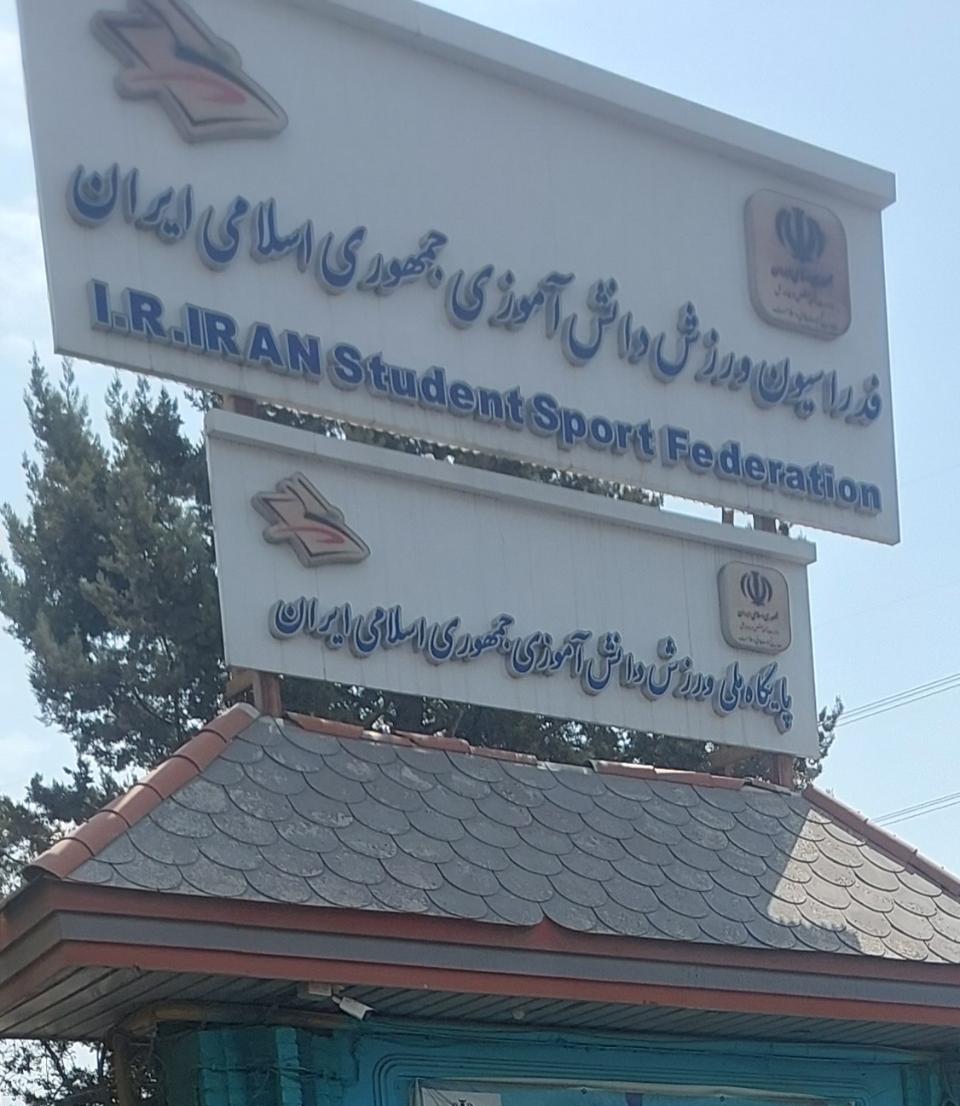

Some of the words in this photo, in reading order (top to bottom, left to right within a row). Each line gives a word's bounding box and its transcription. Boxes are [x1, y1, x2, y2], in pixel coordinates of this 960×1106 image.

[68, 164, 194, 243] ایران
[200, 195, 315, 271] اسلامی
[317, 226, 447, 295] جمهوری
[447, 264, 574, 338] آموزی
[562, 277, 649, 367] دانش
[649, 302, 752, 389] ورزش
[88, 279, 324, 384] I.R.IRAN
[328, 343, 525, 430] Student
[527, 390, 655, 462] Sport
[661, 424, 883, 514] Federation
[752, 357, 882, 427] فدراسیون
[269, 596, 352, 649] ایران
[351, 605, 426, 658] اسلامی
[425, 612, 514, 666] جمهوری
[506, 629, 592, 678] آموزی
[581, 630, 645, 695] دانش
[642, 635, 714, 701] ورزش
[713, 661, 743, 717] ملی
[743, 661, 793, 734] پایگاه
